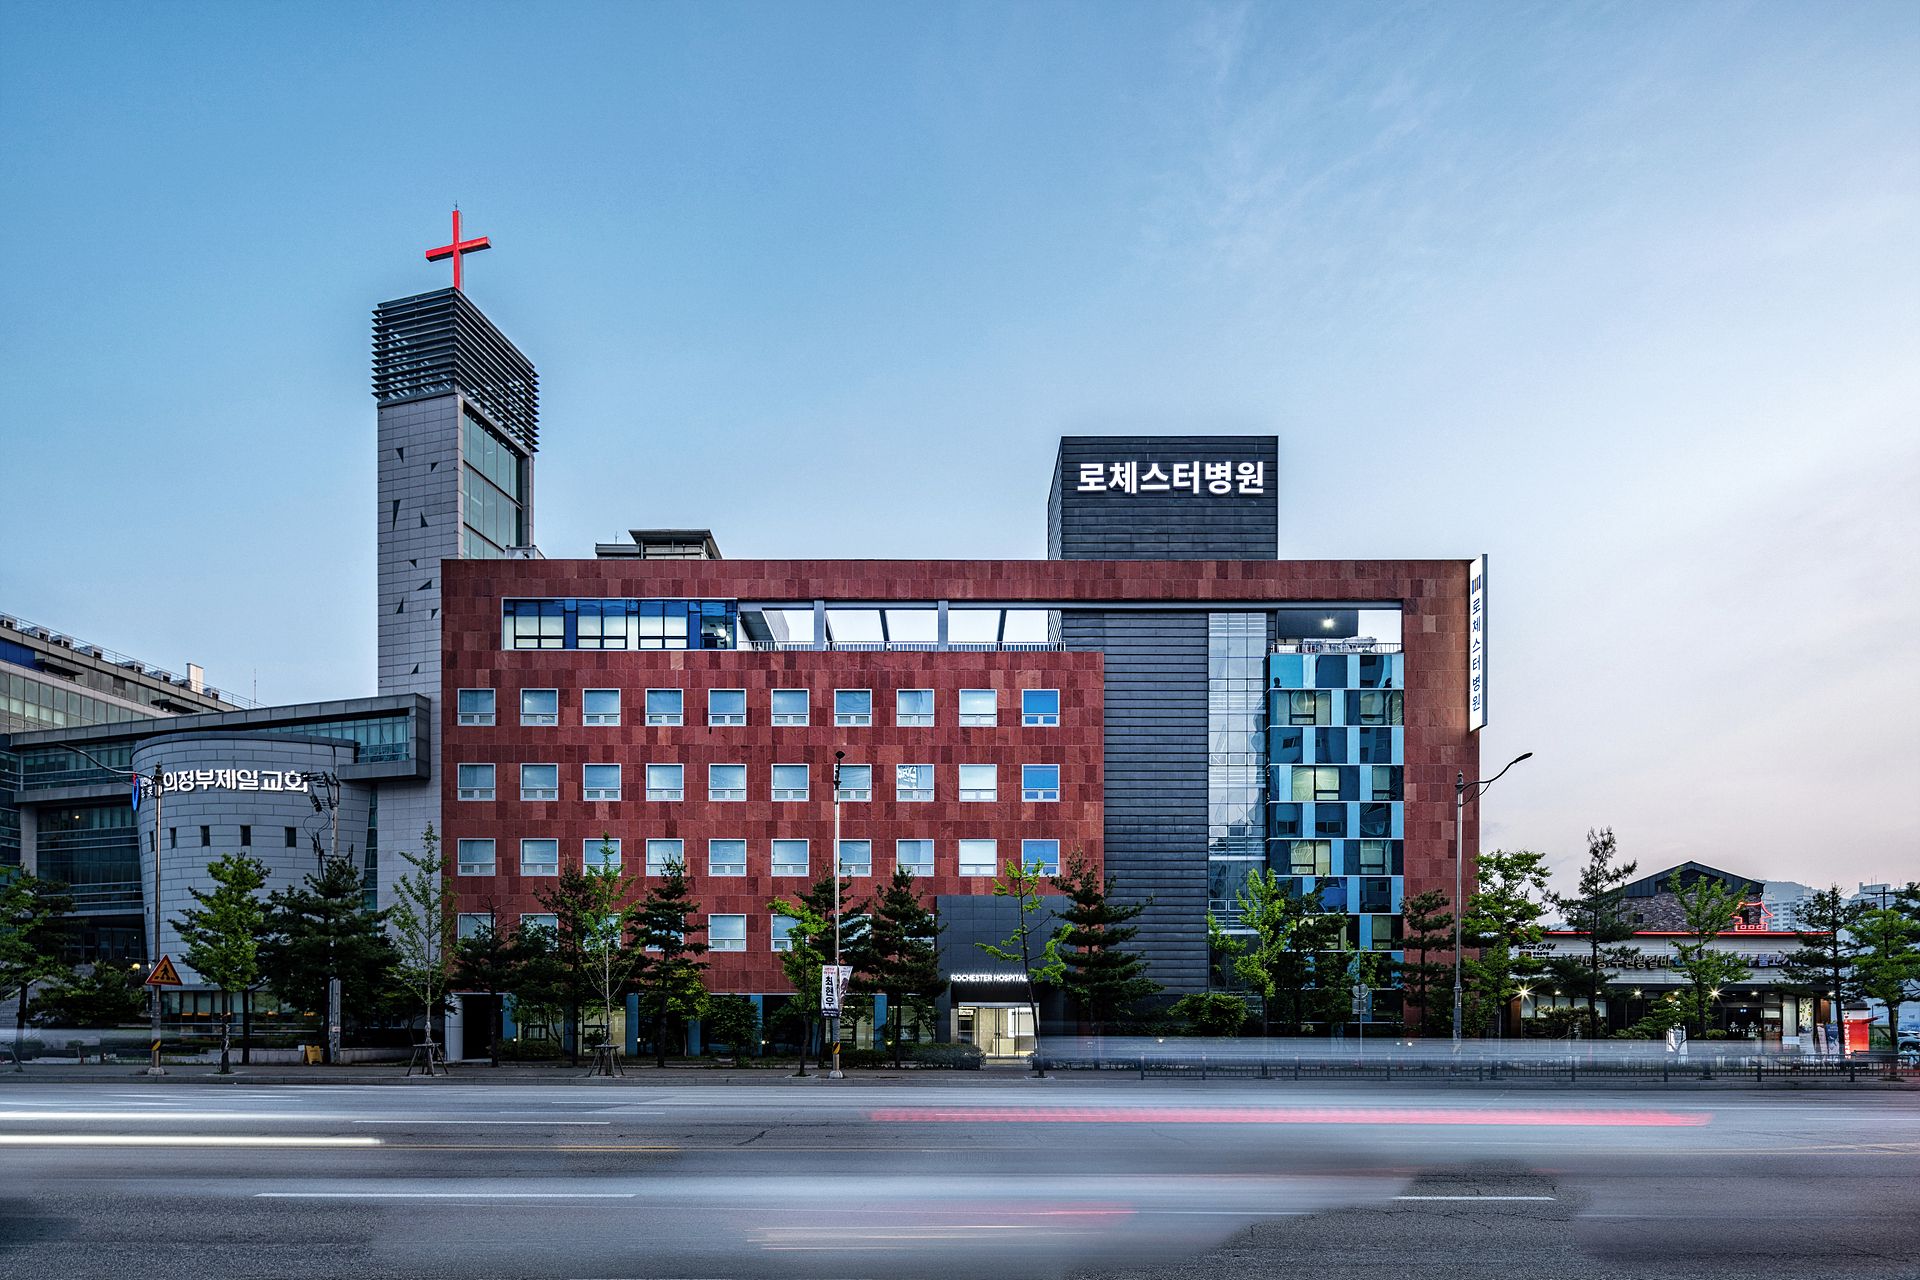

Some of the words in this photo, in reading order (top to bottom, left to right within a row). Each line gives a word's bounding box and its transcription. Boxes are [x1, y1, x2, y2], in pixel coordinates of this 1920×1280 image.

[1077, 461, 1264, 494] 로체스터병원
[1472, 597, 1481, 712] 로체스터병원
[163, 768, 308, 792] 의정부제일교회
[1537, 943, 1557, 951] 1984
[950, 974, 993, 982] ROCHESTER
[994, 974, 1028, 982] HOSPITAL
